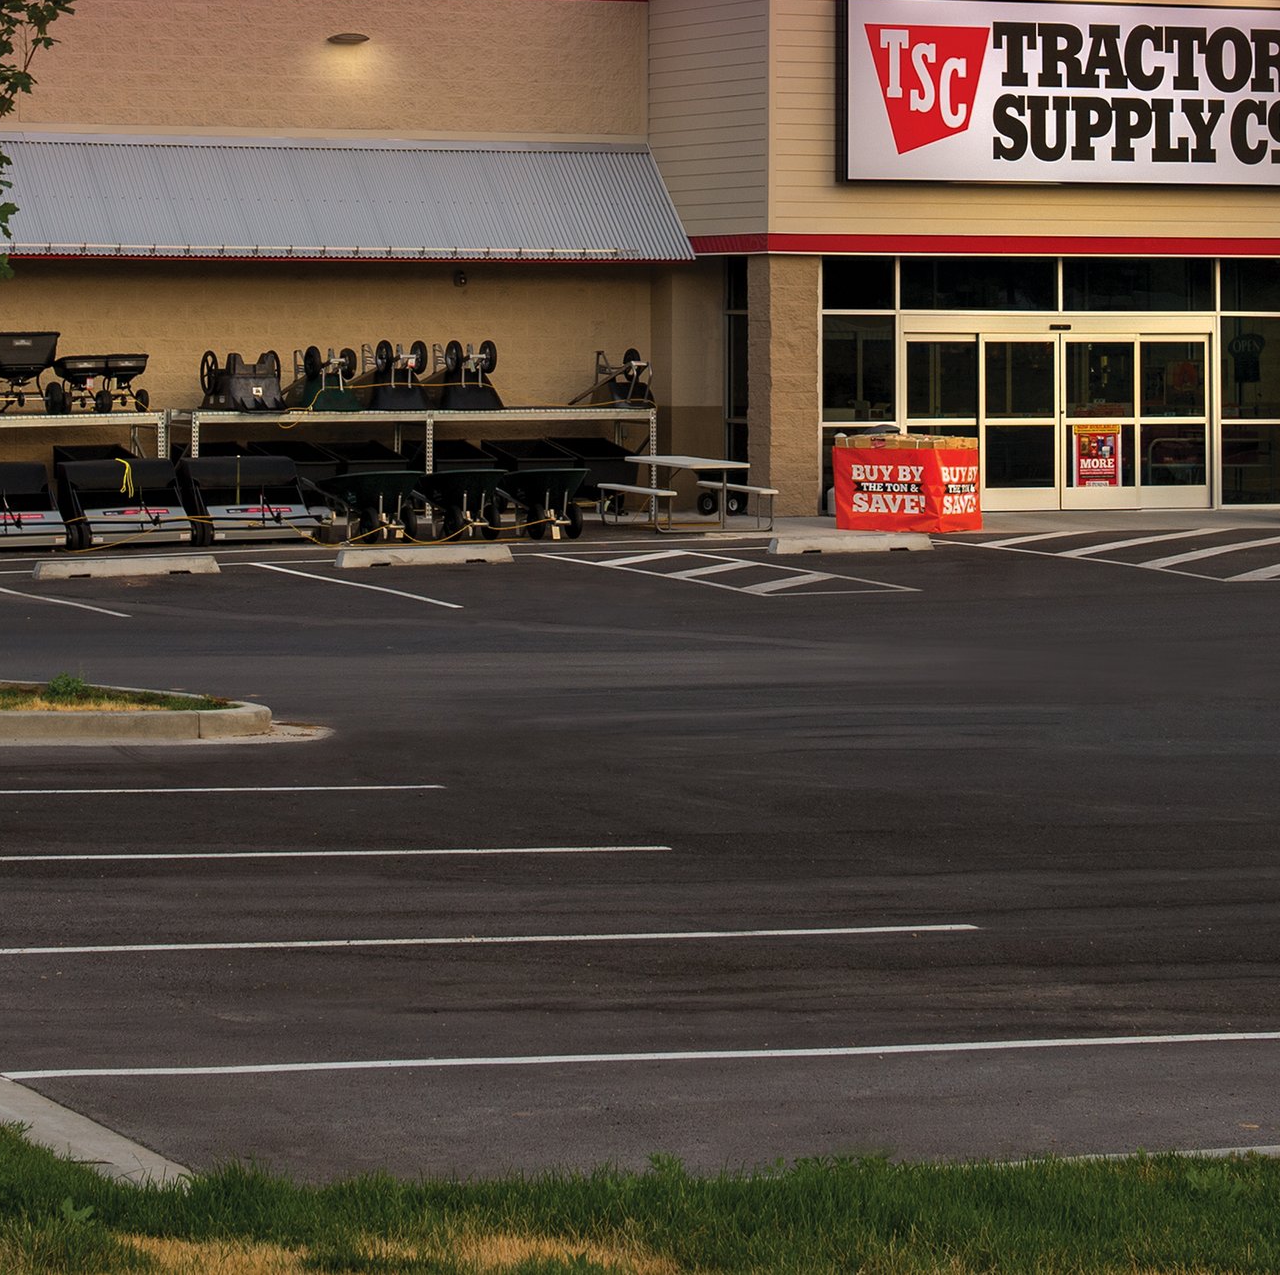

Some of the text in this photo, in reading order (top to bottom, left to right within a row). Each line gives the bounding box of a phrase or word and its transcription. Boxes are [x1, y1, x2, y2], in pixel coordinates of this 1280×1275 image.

[879, 28, 968, 128] TSC
[992, 93, 1225, 164] SUPPLY
[1232, 339, 1261, 353] OPEN
[1080, 458, 1115, 469] MORE
[851, 464, 924, 482] BUY BY
[941, 466, 978, 482] BUY BY
[860, 482, 919, 493] THE TON &
[852, 493, 926, 514] SAVE!
